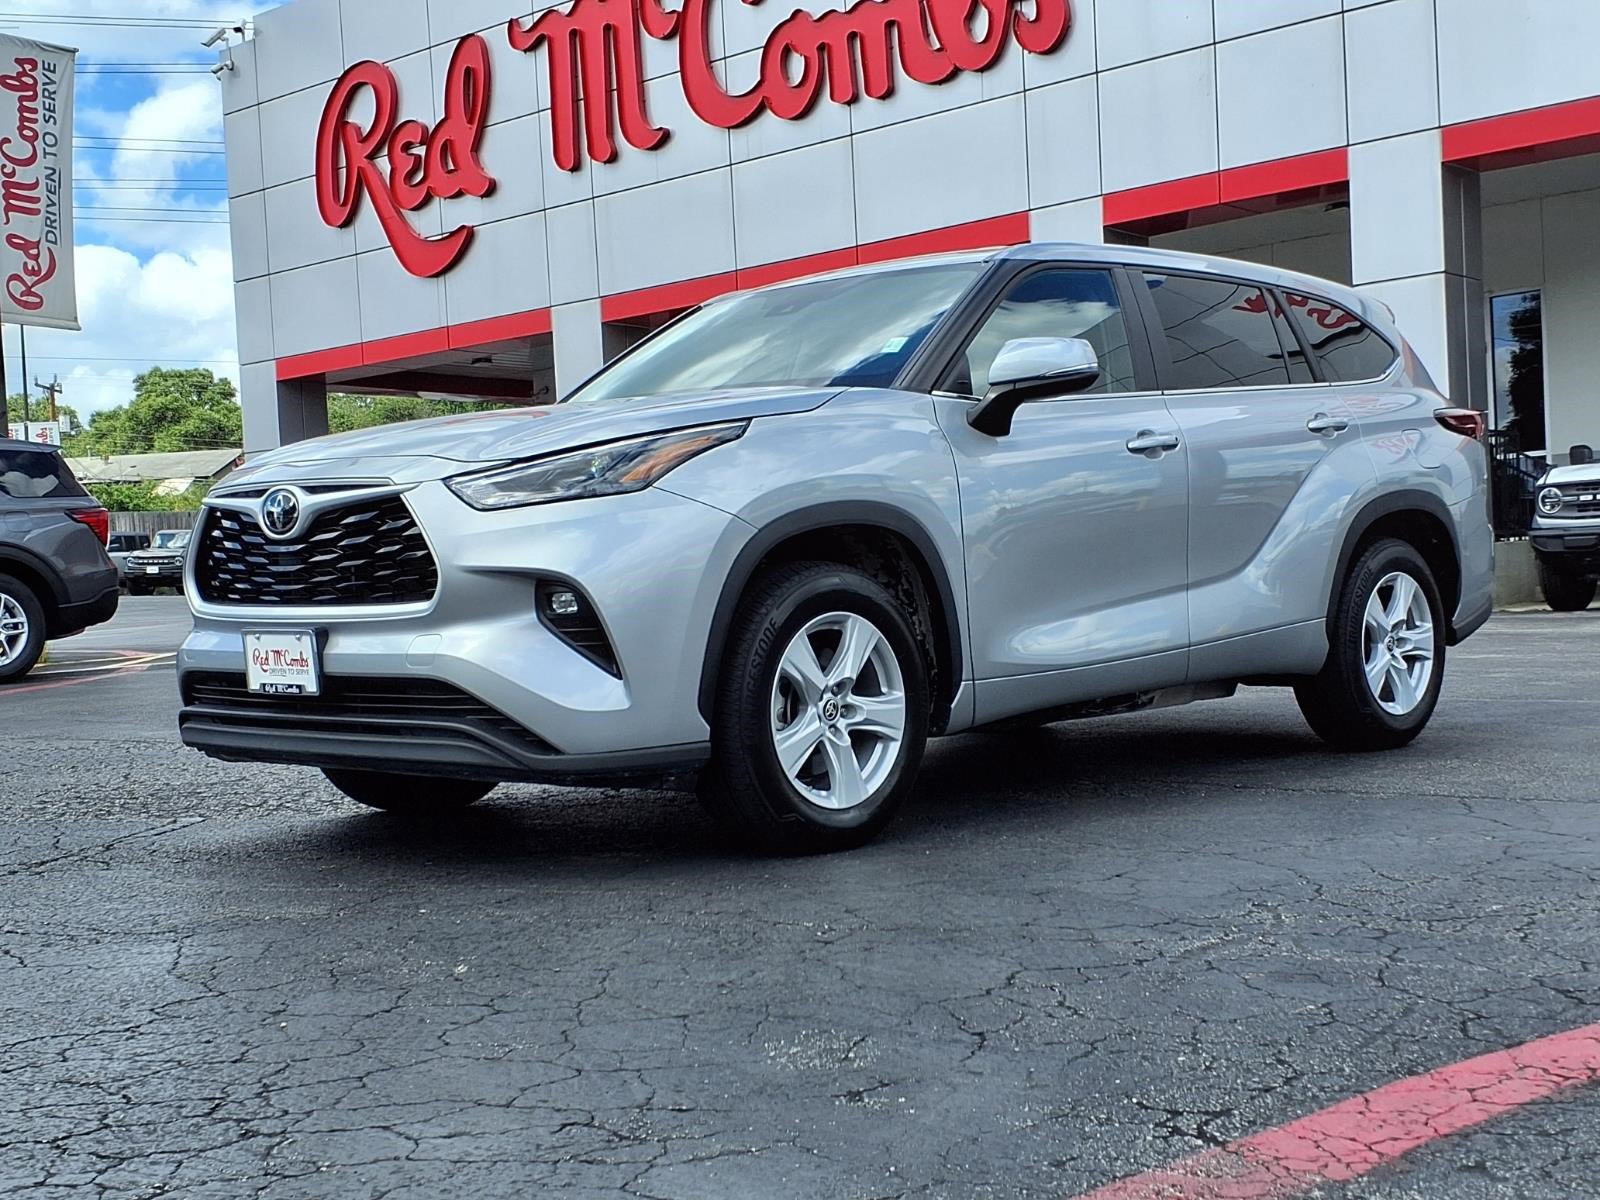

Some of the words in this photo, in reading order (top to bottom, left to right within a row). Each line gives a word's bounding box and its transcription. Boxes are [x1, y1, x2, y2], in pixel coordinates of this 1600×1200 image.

[42, 59, 57, 126] SERVE
[0, 57, 41, 225] McCombs
[42, 131, 58, 160] TO
[314, 33, 496, 278] Red
[44, 166, 58, 246] DRIVEN
[5, 233, 57, 311] Red
[252, 647, 270, 673] Red
[270, 648, 309, 668] McCombs
